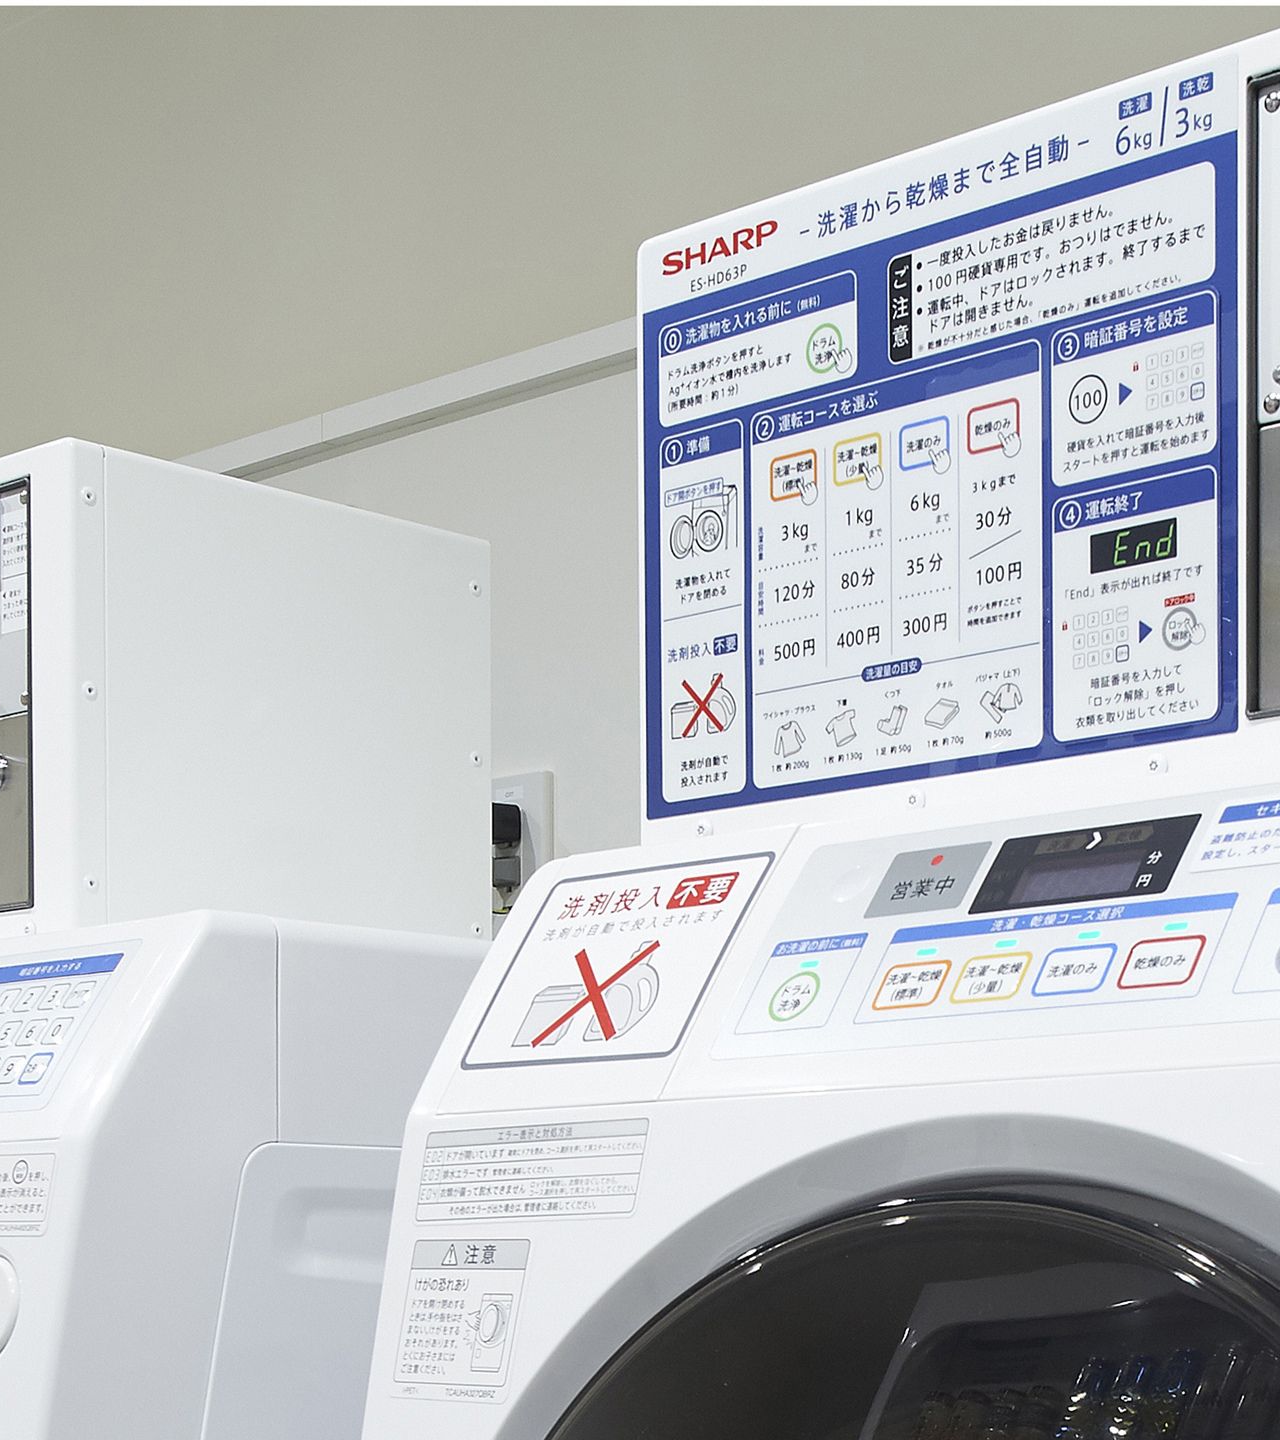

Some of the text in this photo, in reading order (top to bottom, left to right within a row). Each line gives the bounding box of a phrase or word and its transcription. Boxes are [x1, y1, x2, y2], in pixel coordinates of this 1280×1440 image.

[1182, 75, 1210, 97] 洗乾
[1122, 95, 1150, 117] 洗濯
[1175, 108, 1213, 139] 3kg
[1116, 125, 1152, 155] 6kg
[818, 134, 1070, 238] 洗濯から乾燥まで全自動
[663, 220, 778, 275] SHARP
[926, 205, 1113, 266] 一度投入したお金は戻りません。
[691, 264, 747, 292] ES-HD63P
[892, 266, 909, 349] ご注意
[929, 294, 1033, 333] ドアは開きません。
[686, 300, 791, 345] 洗濯物を入れる前に
[1084, 306, 1188, 349] 暗証番号を設定
[812, 336, 836, 349] ドラム
[668, 344, 763, 380] ドラム洗浄ボタンを押すと
[778, 390, 878, 434] 運転コースを選ぶ
[1074, 390, 1102, 410] 100
[975, 420, 1011, 436] 乾燥のみ
[1067, 411, 1205, 454] 硬貨を入れて暗証番号を入力後
[686, 436, 710, 456] 準備
[906, 434, 942, 454] 洗濯のみ
[1064, 429, 1210, 473] スタートを押すと運転を始めます
[910, 492, 940, 512] 6kg
[1085, 491, 1143, 521] 運転終了
[846, 507, 874, 527] 1kg
[976, 506, 1012, 530] 30分
[781, 522, 808, 542] 3kg
[1113, 524, 1175, 566] End
[906, 553, 943, 576] 35分
[976, 561, 1022, 586] 100円
[675, 569, 732, 590] 洗濯物を入れて
[841, 568, 875, 589] 80分
[679, 586, 727, 605] ドアを閉める
[775, 580, 815, 603] 120分
[903, 612, 948, 637] 300円
[667, 635, 736, 663] 洗剤投入 不要
[836, 625, 881, 649] 400円
[774, 638, 816, 661] 500円
[866, 660, 918, 680] 洗濯量の目安
[1090, 663, 1182, 689] 暗証番号を入力して
[1075, 701, 1199, 729] 衣類を取り出してください
[680, 755, 729, 773] 洗剤が自動で
[681, 770, 728, 788] 投入されます
[1147, 850, 1163, 864] 分
[891, 875, 955, 901] 営業中
[1135, 873, 1153, 888] 円
[557, 875, 735, 920] 洗剤投入 不要
[543, 909, 724, 941] 洗剤が自動で投入されます
[990, 906, 1125, 930] 洗濯・乾燥コース選択
[1047, 962, 1098, 978] 洗濯のみ
[1134, 954, 1186, 970] 乾燥のみ
[781, 984, 811, 997] ドラム
[777, 998, 801, 1013] 洗浄
[463, 1245, 497, 1265] 注意
